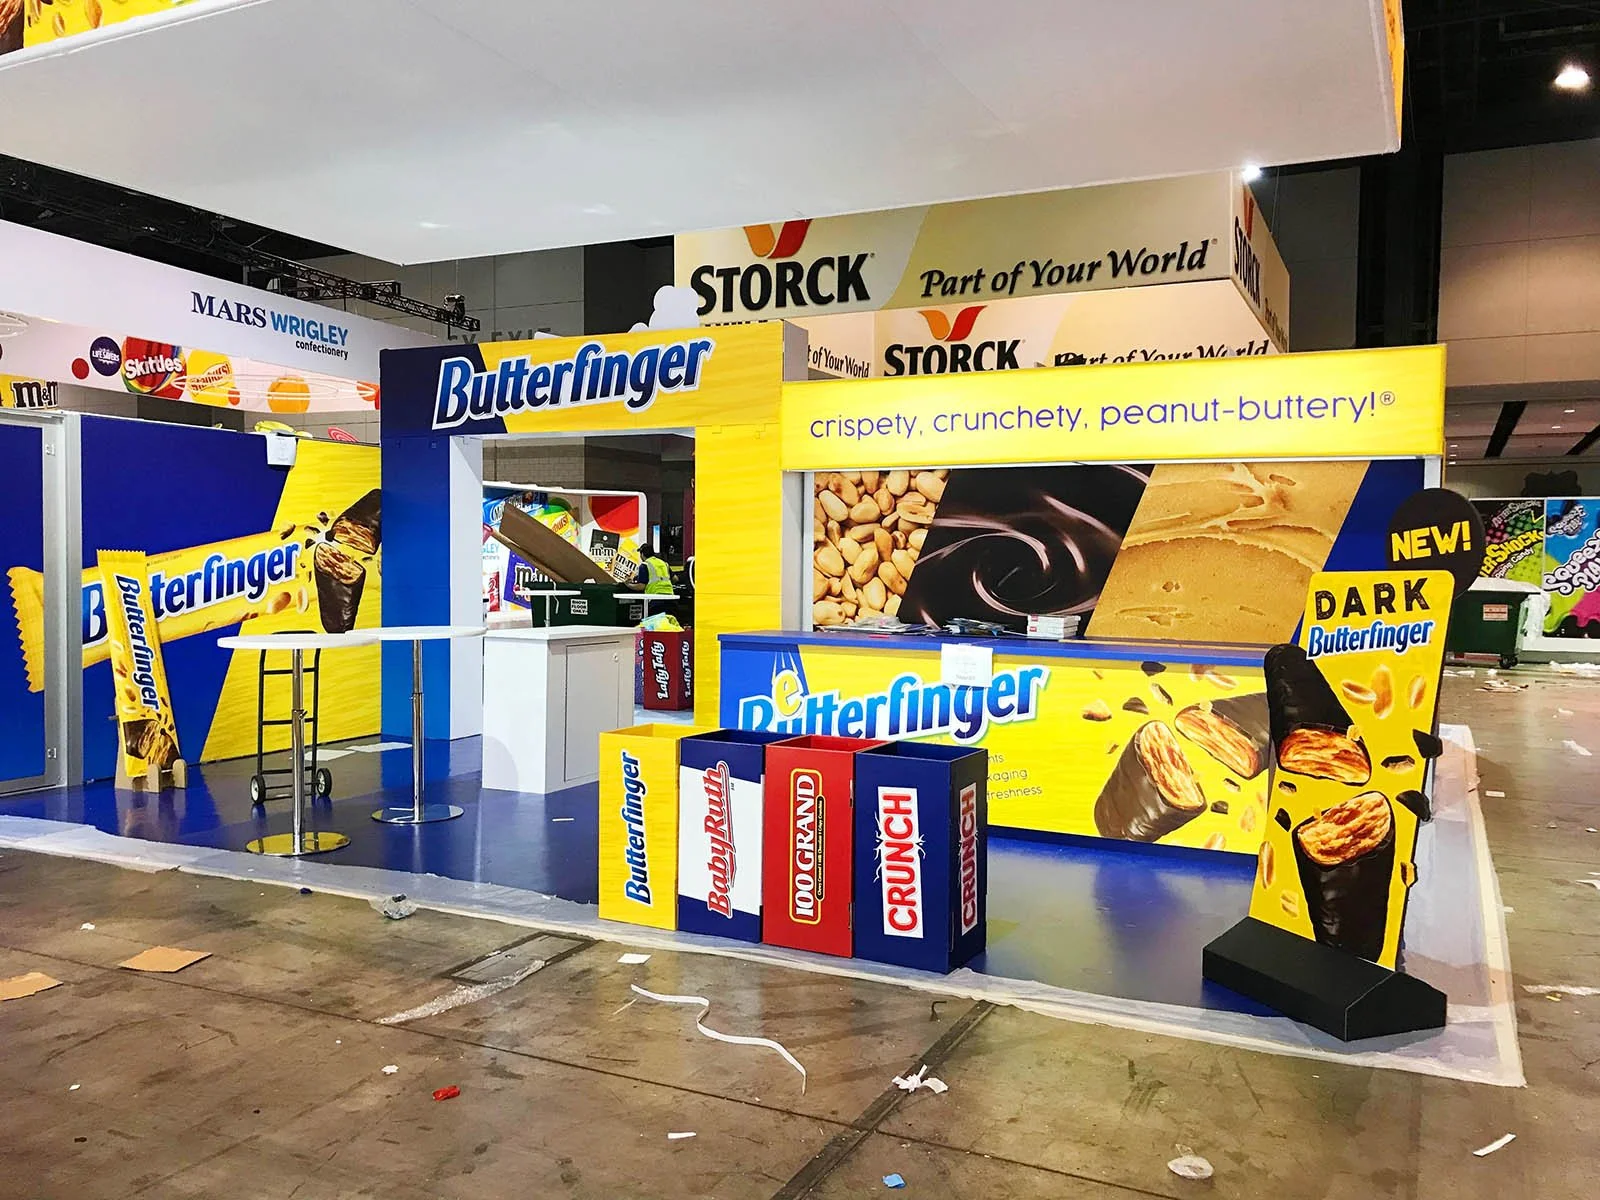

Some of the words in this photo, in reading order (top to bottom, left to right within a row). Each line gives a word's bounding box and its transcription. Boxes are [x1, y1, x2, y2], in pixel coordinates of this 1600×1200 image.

[690, 252, 871, 316] STORCK
[920, 267, 986, 298] Part
[991, 260, 1025, 294] of
[1029, 258, 1102, 288] Your
[1107, 239, 1210, 279] World
[1234, 215, 1261, 309] STORCK
[191, 291, 266, 329] MARS
[270, 311, 348, 347] WRIGLEY
[124, 354, 183, 380] Skittles
[296, 340, 349, 361] confectionery
[812, 346, 824, 369] of
[824, 348, 845, 373] Your
[845, 355, 870, 378] World
[884, 338, 1021, 377] STORCK
[432, 337, 714, 430] Butterfinger
[810, 409, 924, 440] crispety,
[933, 402, 1089, 433] crunchety,
[1390, 520, 1472, 562] NEW!
[1511, 546, 1535, 563] Candy
[82, 541, 303, 648] Bterfinger
[1314, 577, 1430, 621] DARK
[114, 573, 160, 713] Butterfinger
[651, 641, 665, 669] Taffy
[1306, 620, 1434, 659] Butterfinger
[655, 668, 669, 699] Laffy
[740, 666, 1049, 745] Btterfinger
[621, 748, 652, 906] Butterfinger
[795, 774, 815, 872] GRAND
[882, 792, 919, 932] CRUNCH
[960, 787, 976, 928] CRUNCH
[794, 872, 815, 917] 100
